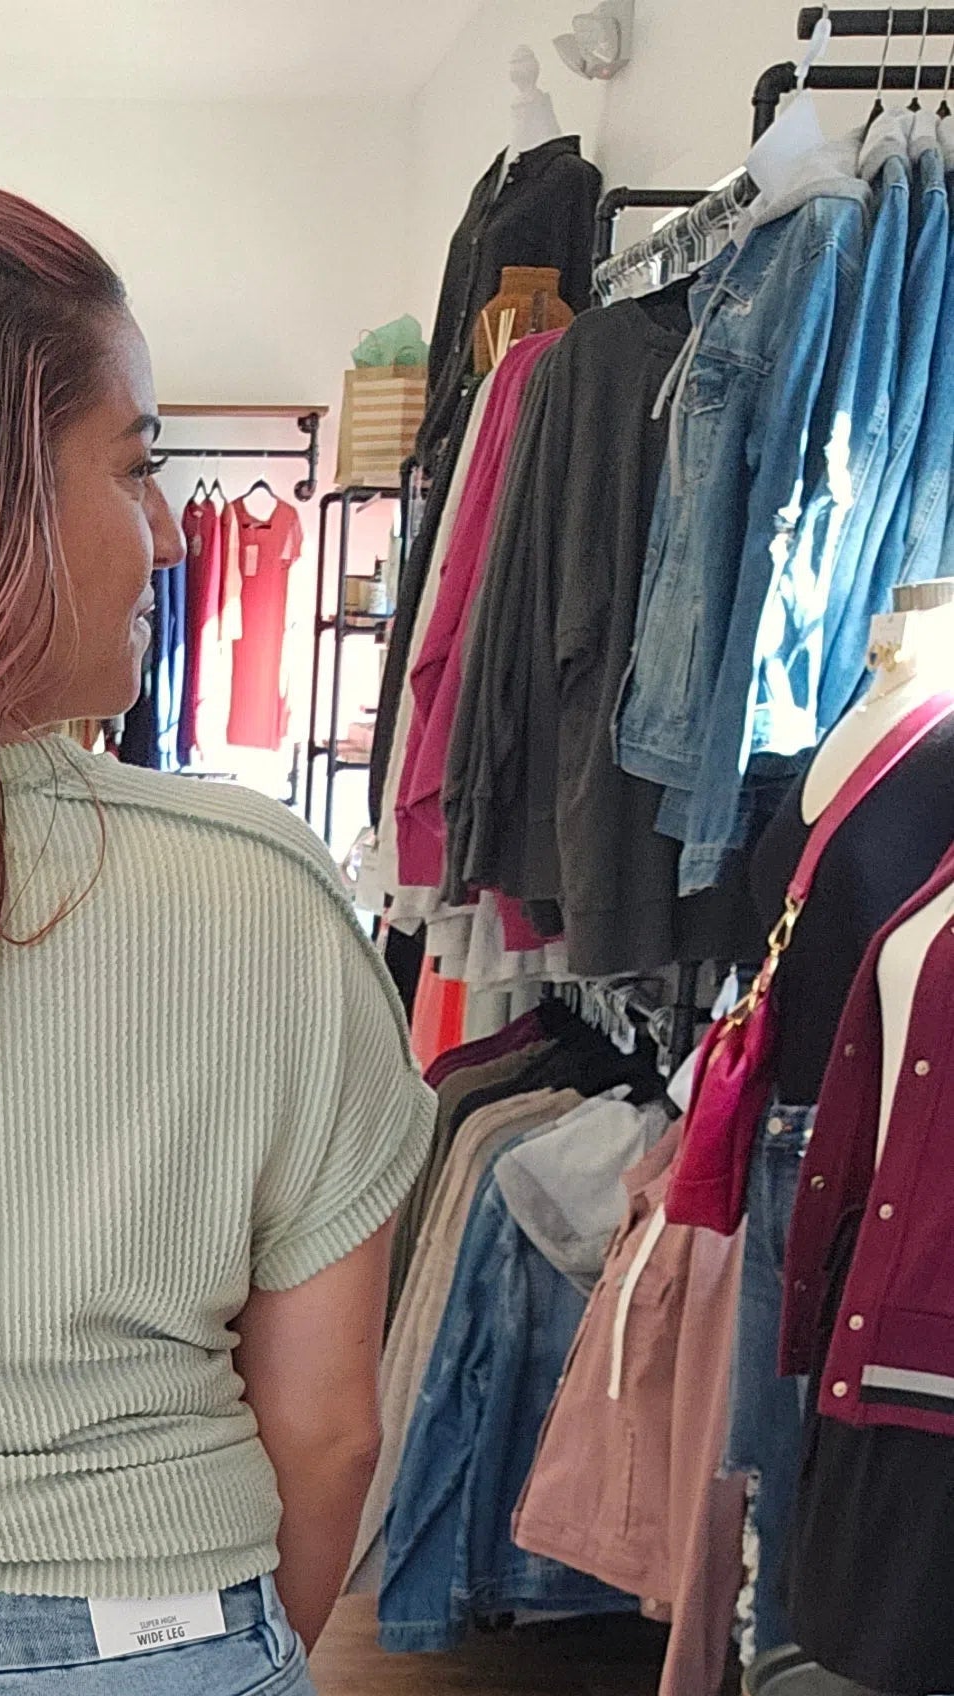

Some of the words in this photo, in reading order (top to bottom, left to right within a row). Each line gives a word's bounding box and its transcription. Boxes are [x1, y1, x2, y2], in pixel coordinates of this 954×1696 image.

[140, 1619, 160, 1630] SUPER
[161, 1616, 177, 1624] HIGH
[137, 1630, 164, 1646] WIDE
[167, 1626, 185, 1641] LEG
